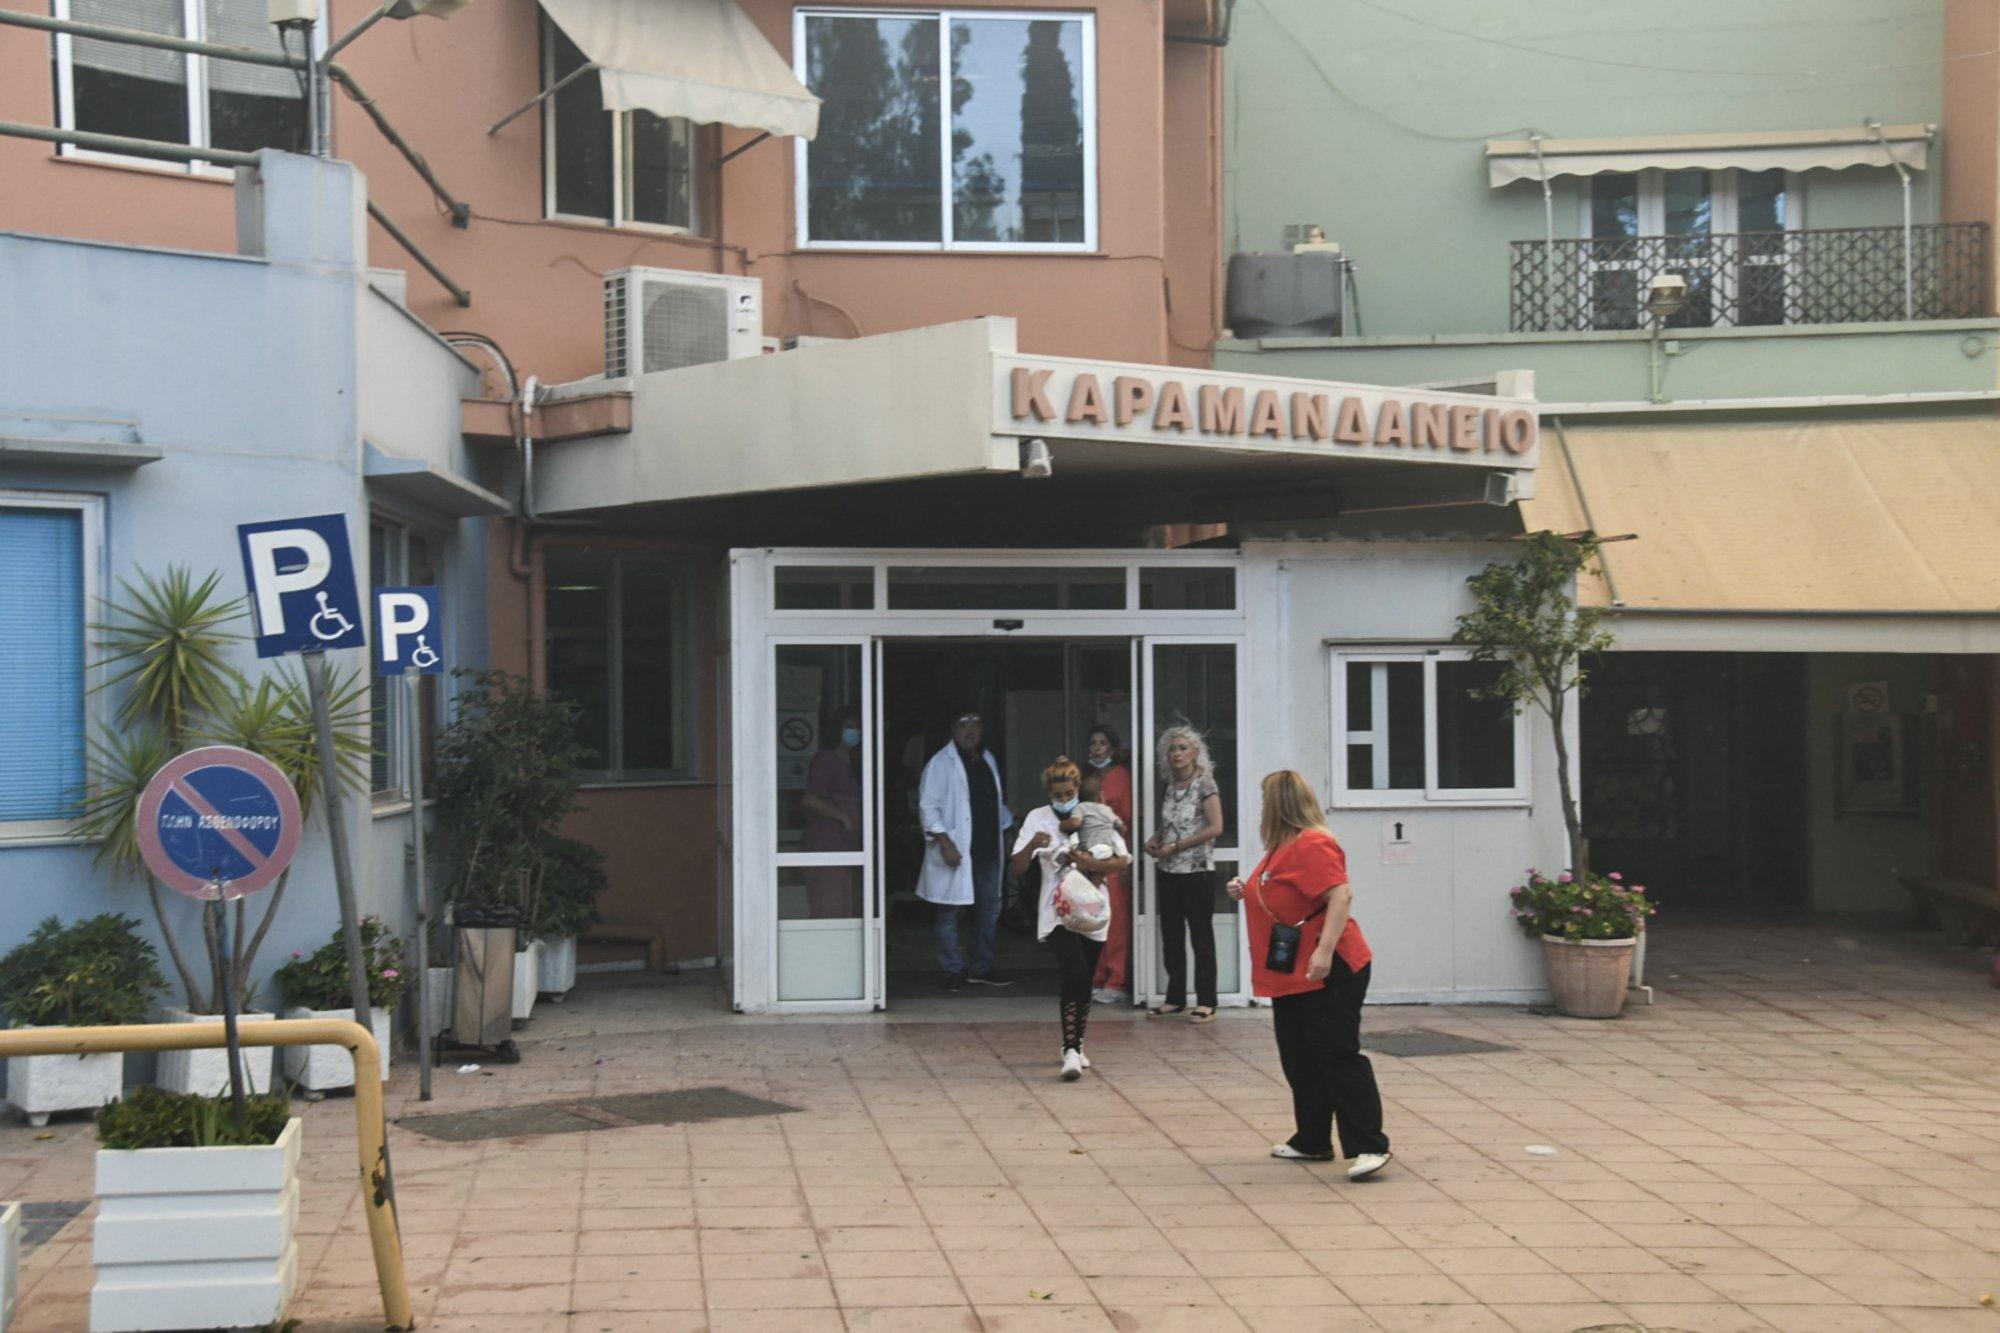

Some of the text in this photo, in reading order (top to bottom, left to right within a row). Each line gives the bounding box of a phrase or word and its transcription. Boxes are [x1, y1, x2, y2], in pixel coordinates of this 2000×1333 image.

[1011, 366, 1535, 455] ΚΑΡΑΜΑΝΔΑΝΕΙΟ
[247, 528, 332, 636] P
[379, 592, 430, 662] P
